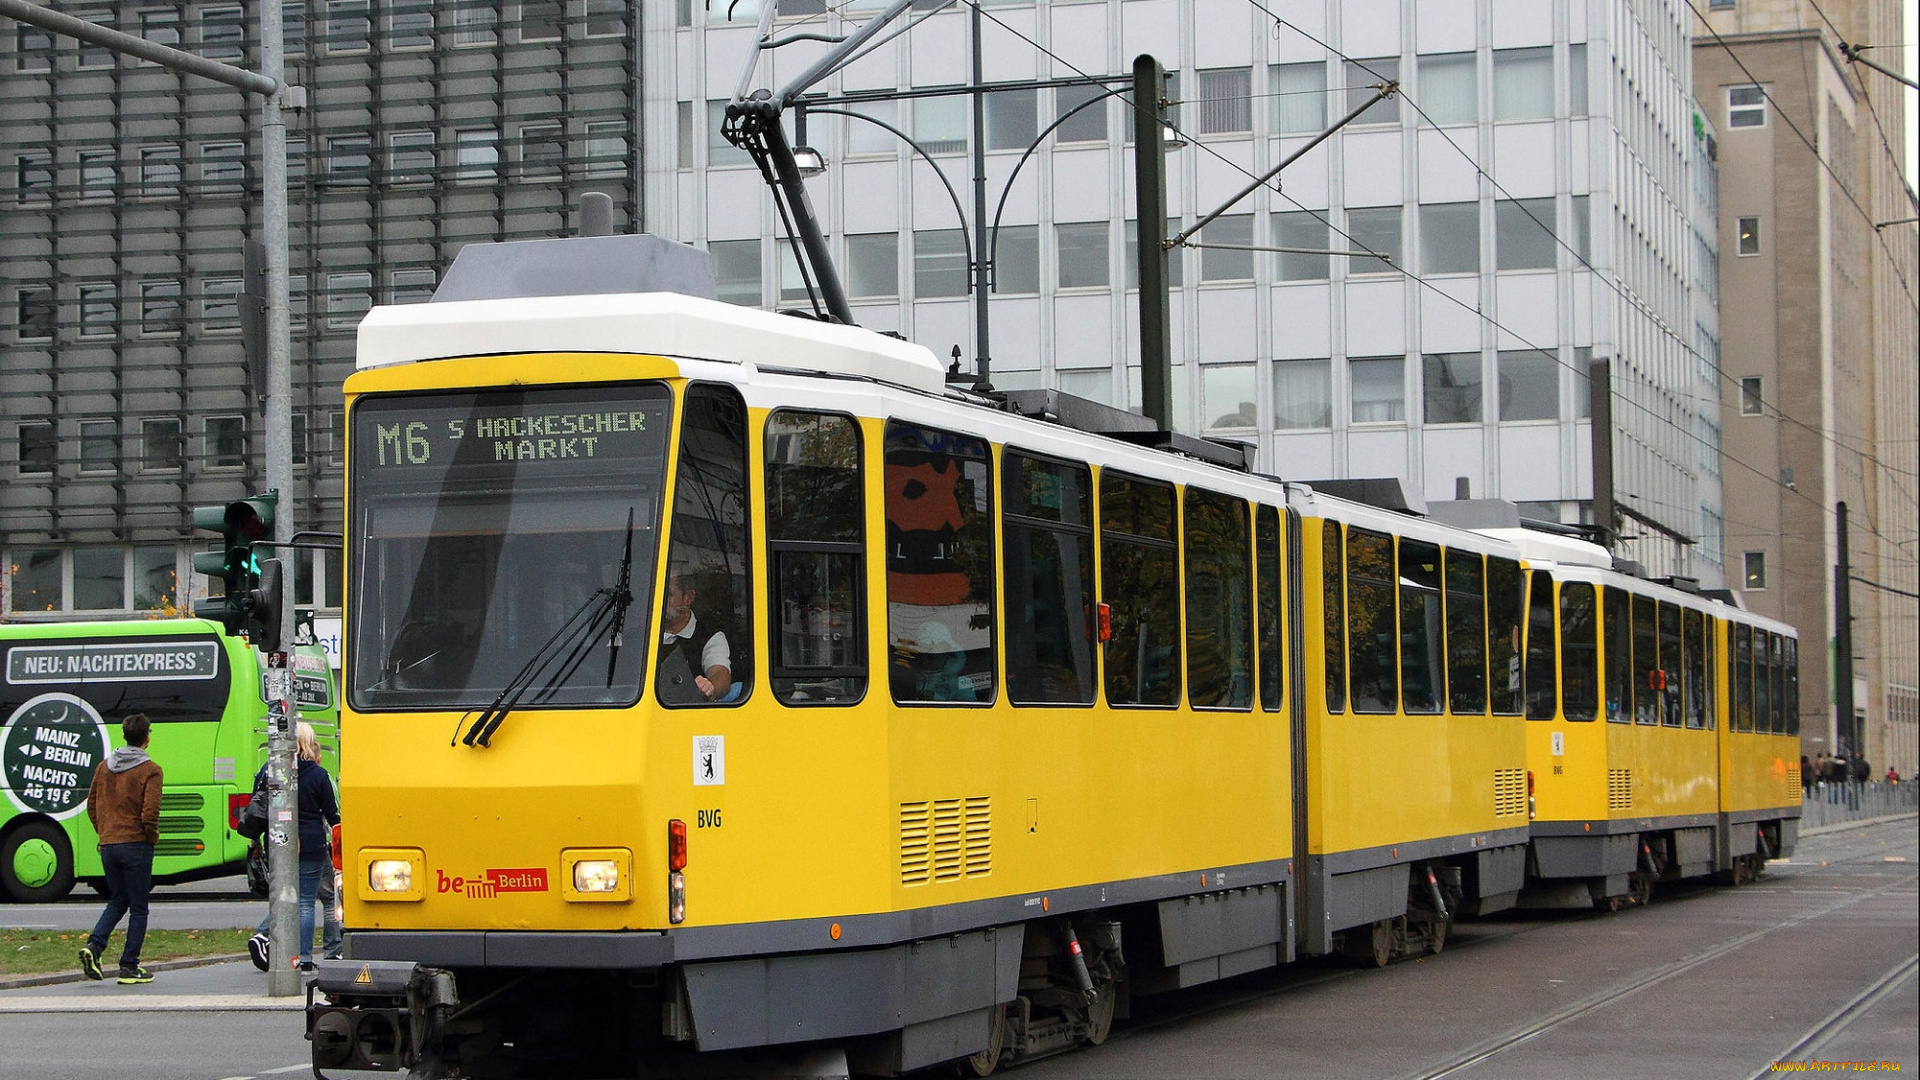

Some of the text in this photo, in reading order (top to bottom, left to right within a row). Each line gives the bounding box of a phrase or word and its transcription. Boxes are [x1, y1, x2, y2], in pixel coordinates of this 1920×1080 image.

[449, 411, 646, 439] S HACKESCHER
[377, 421, 430, 465] M6
[494, 436, 598, 461] MARKT
[25, 652, 197, 674] NEU: NACHTEXPRESS
[35, 726, 81, 748] MAINZ
[44, 745, 92, 767] BERLIN
[23, 764, 78, 787] NACHTS
[23, 782, 71, 804] AB 19 €
[698, 809, 722, 828] BVG
[436, 869, 542, 893] be Berlin
